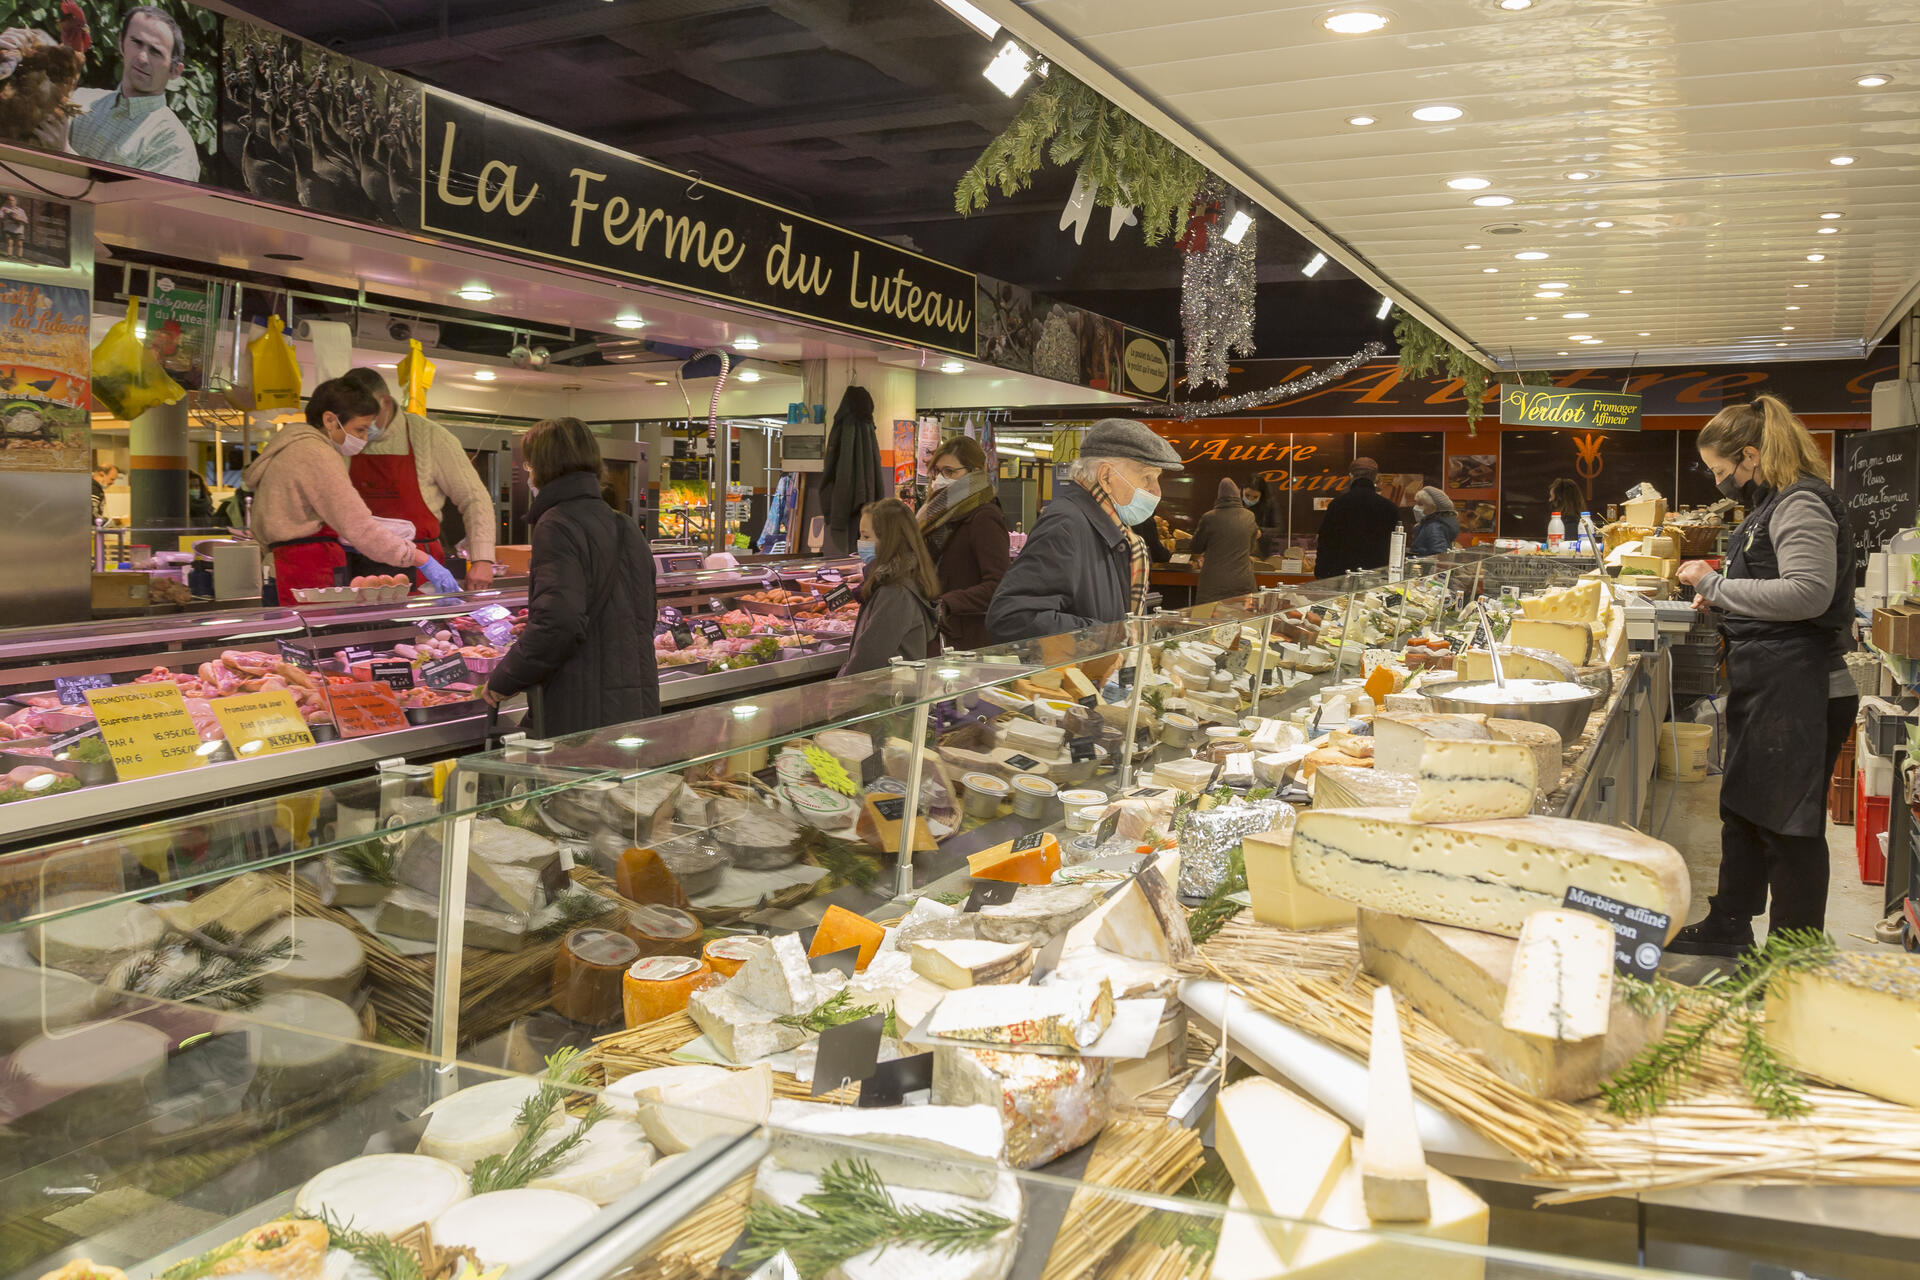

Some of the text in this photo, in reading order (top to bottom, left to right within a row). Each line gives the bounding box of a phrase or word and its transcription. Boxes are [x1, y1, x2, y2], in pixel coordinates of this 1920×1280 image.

[438, 121, 972, 333] La Ferme du Luteau
[155, 309, 170, 320] du
[1510, 391, 1638, 424] Verdot Fromager
[1591, 412, 1630, 427] Affineur
[1886, 453, 1903, 464] aux
[91, 694, 140, 705] PROMOTION
[142, 712, 153, 720] de
[107, 738, 128, 748] PAR
[129, 737, 135, 745] 4
[114, 755, 134, 765] PAR
[134, 754, 143, 763] 6
[1567, 887, 1668, 929] Morbier affiné
[1609, 918, 1637, 940] son
